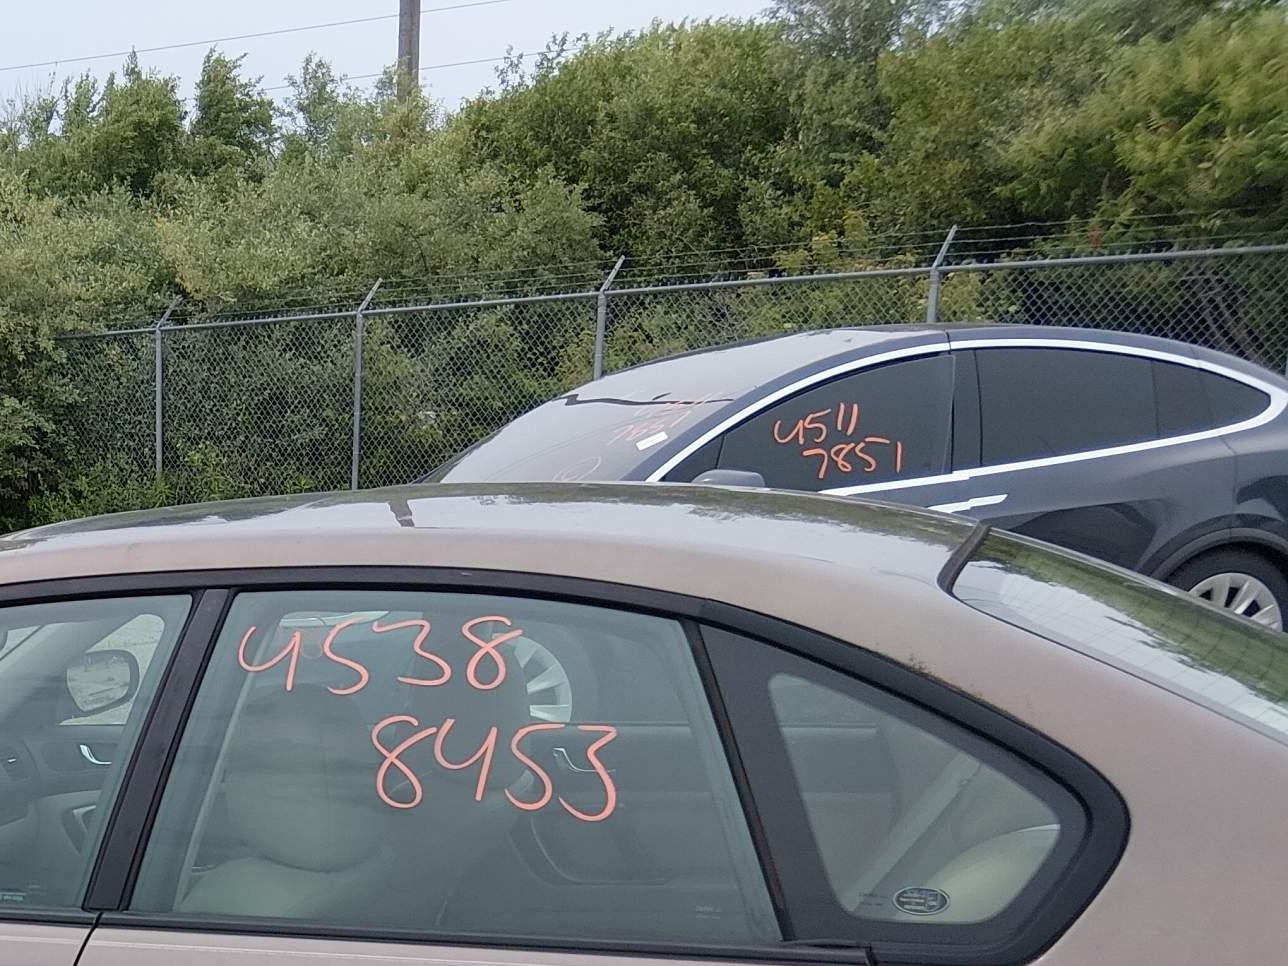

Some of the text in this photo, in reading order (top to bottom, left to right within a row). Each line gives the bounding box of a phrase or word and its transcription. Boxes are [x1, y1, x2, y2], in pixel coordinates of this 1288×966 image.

[773, 402, 859, 445] 4511
[802, 436, 904, 480] 7851
[237, 614, 524, 697] 4538
[368, 714, 619, 823] 8453
